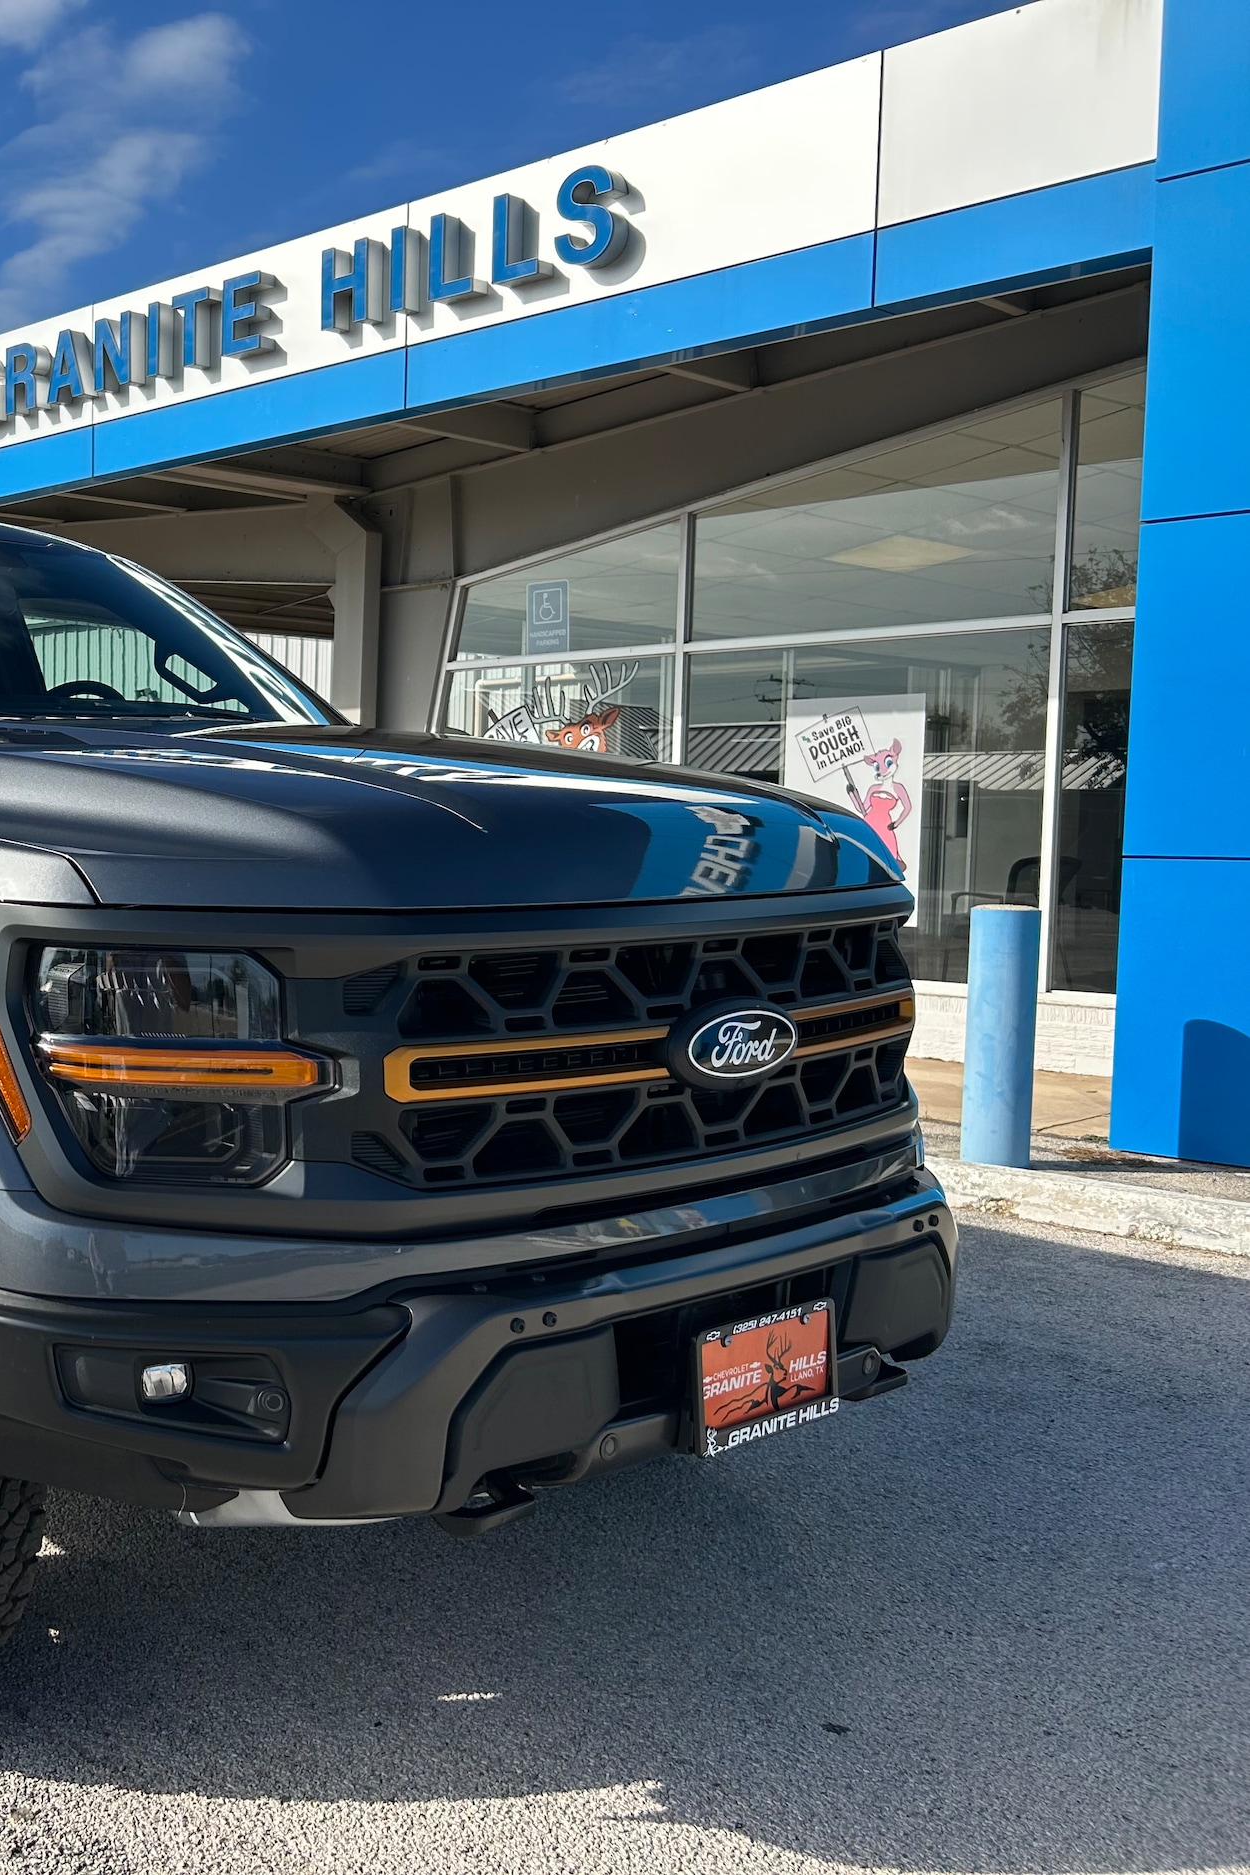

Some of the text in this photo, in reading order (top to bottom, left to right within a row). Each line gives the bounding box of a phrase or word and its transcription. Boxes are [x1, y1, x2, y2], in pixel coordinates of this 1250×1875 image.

[321, 165, 622, 333] HILLS
[529, 629, 566, 638] HANDICAPPED
[488, 712, 529, 740] AVE
[811, 715, 852, 741] Save BIG
[808, 725, 860, 761] DOUGH
[827, 740, 865, 765] LLANO!
[711, 1020, 778, 1068] Ford
[733, 1319, 758, 1335] (325)
[703, 1350, 827, 1400] GRANITE HILLS
[713, 1363, 749, 1381] CHEVROLET
[790, 1365, 824, 1383] LLANO, TX
[728, 1397, 840, 1447] GRANITE HILLS
